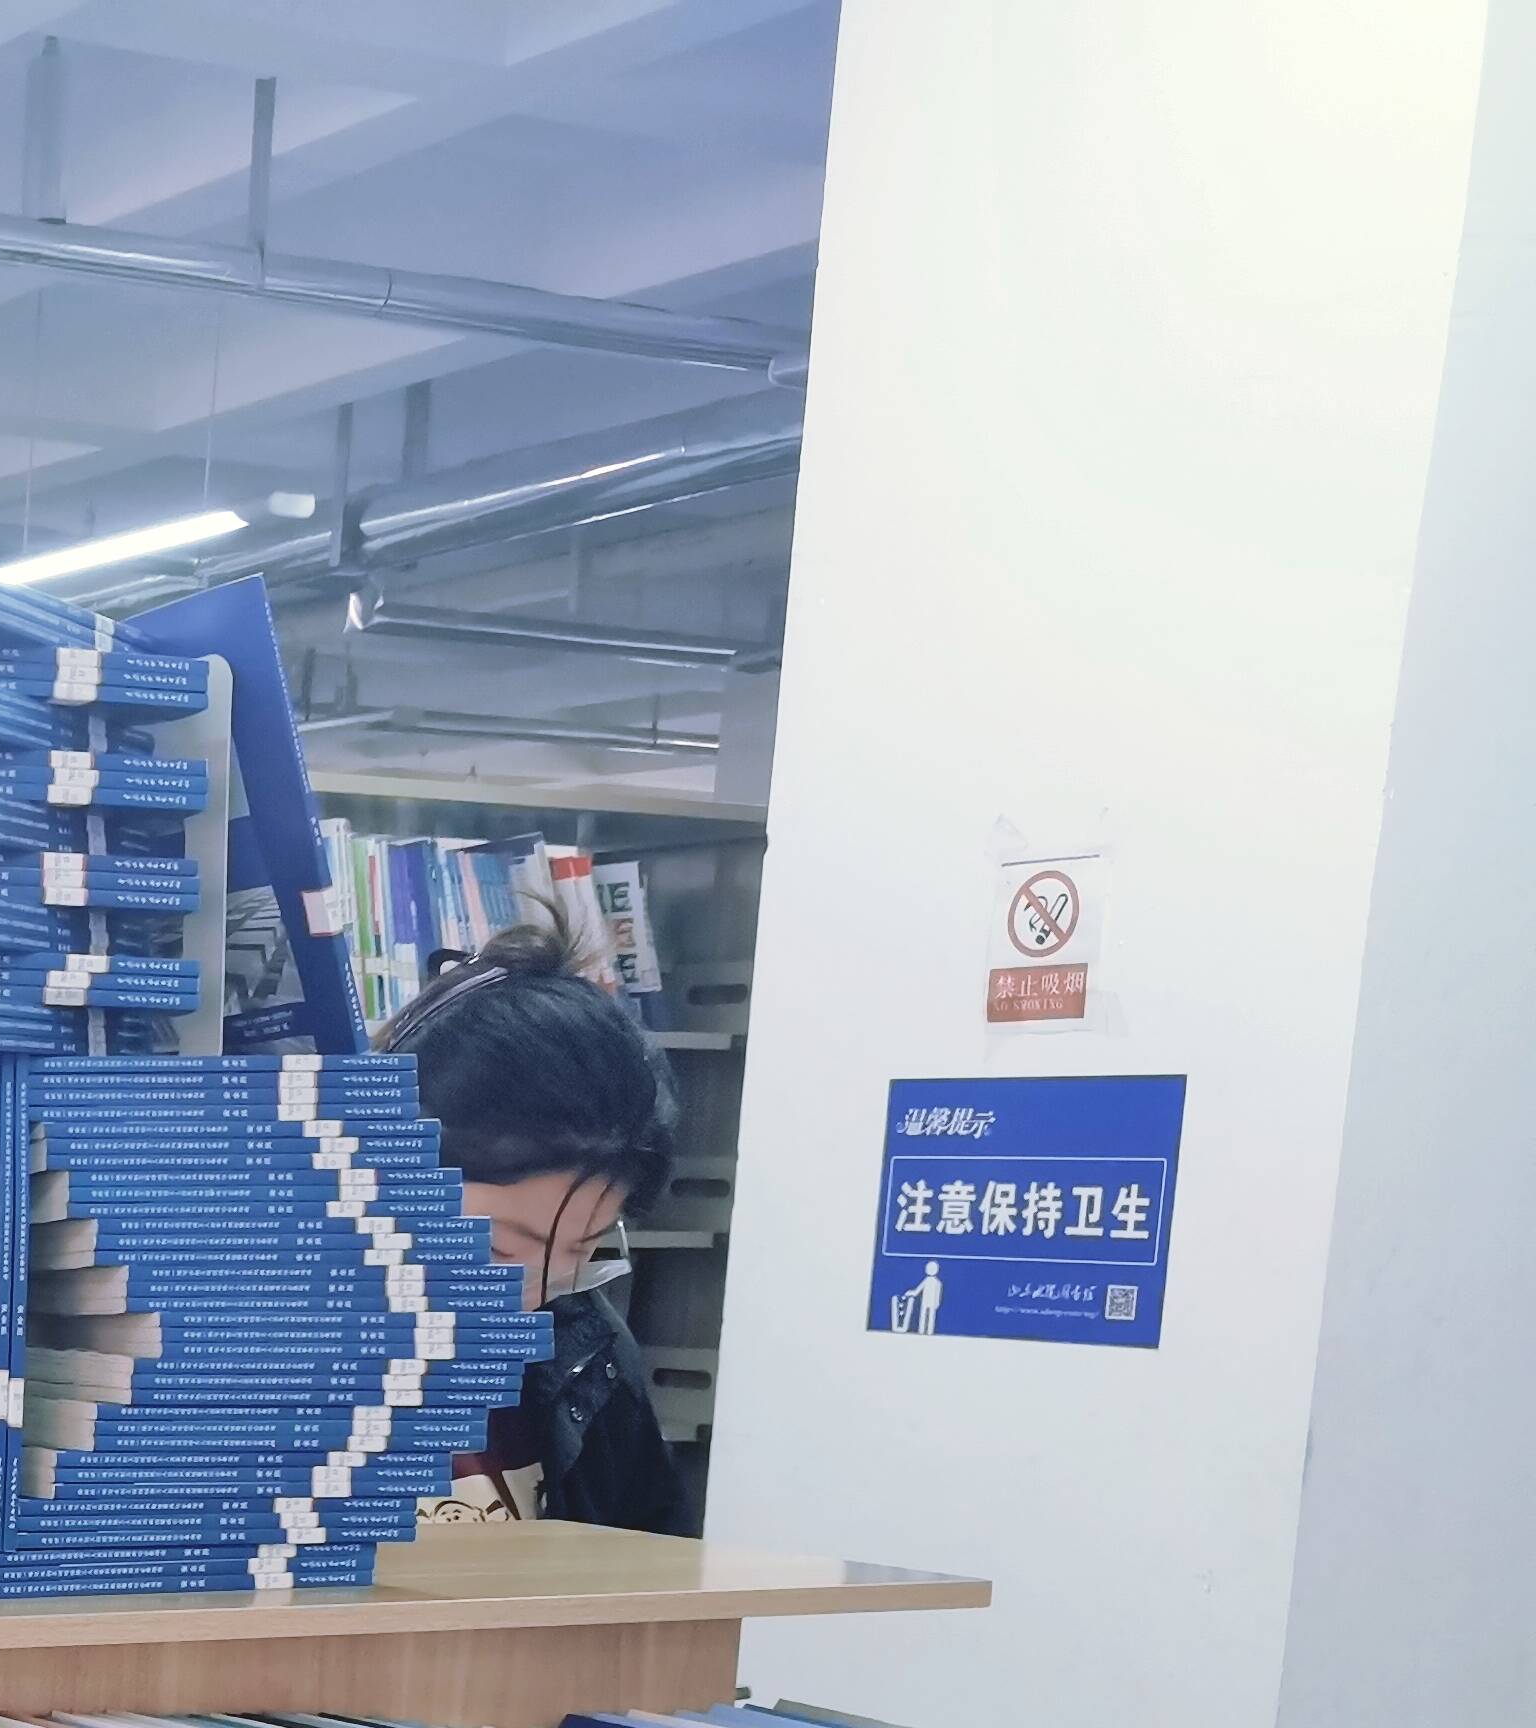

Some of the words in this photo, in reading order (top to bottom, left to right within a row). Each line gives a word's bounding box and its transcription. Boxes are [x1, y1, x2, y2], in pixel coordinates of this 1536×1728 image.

[995, 971, 1084, 999] 禁止吸烟
[896, 1106, 996, 1139] 温馨提示
[895, 1178, 1150, 1240] 注意保持卫生
